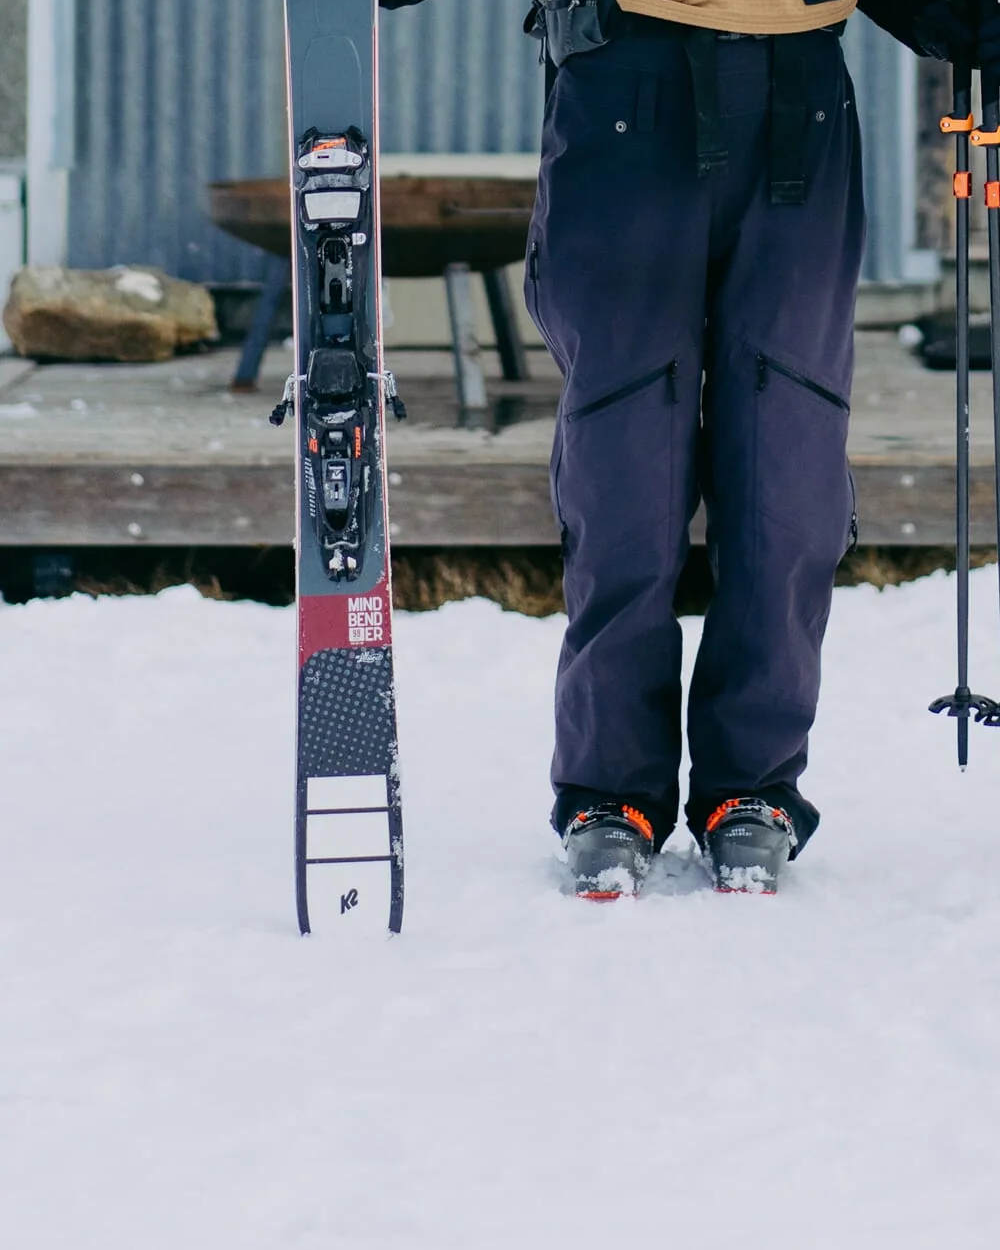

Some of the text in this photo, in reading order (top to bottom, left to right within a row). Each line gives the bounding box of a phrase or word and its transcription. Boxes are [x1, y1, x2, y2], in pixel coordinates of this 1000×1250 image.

[348, 596, 383, 612] MIND
[348, 611, 383, 627] BEND
[365, 626, 384, 641] ER
[340, 888, 359, 915] K2
